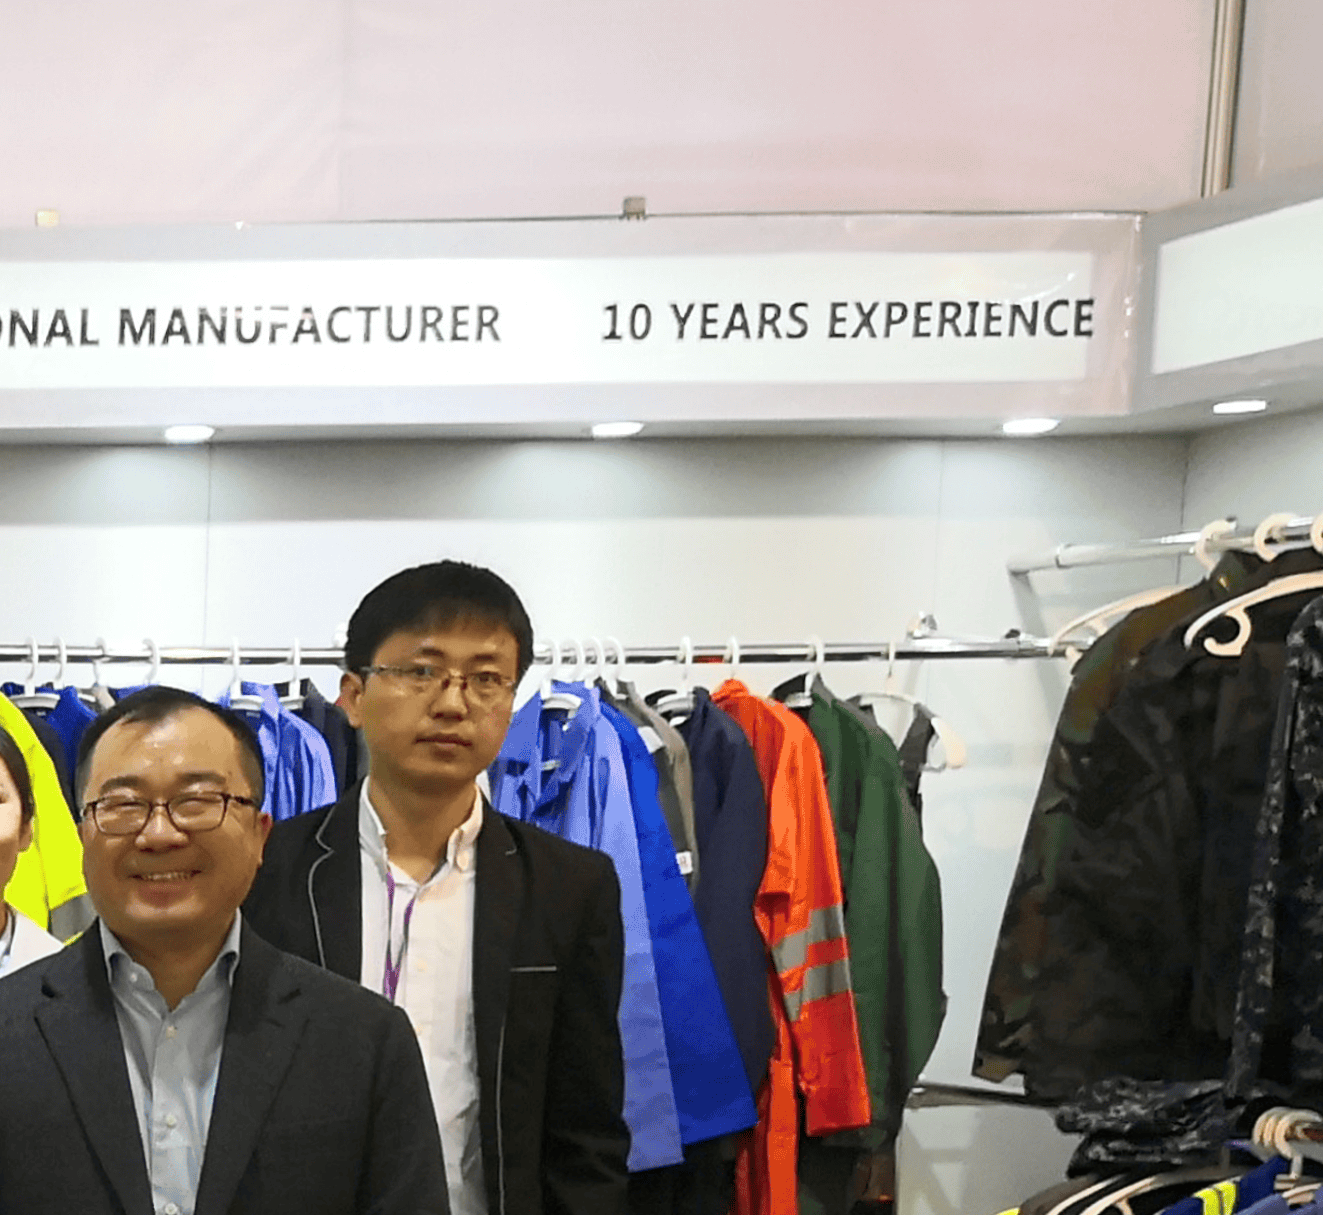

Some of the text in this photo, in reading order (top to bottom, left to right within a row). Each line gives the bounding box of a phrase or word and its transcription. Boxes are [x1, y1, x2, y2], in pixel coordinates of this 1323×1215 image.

[118, 304, 501, 347] MANUFACTURER
[602, 303, 652, 342] 10
[669, 301, 809, 341] YEARS
[827, 297, 1096, 340] EXPERIENCE
